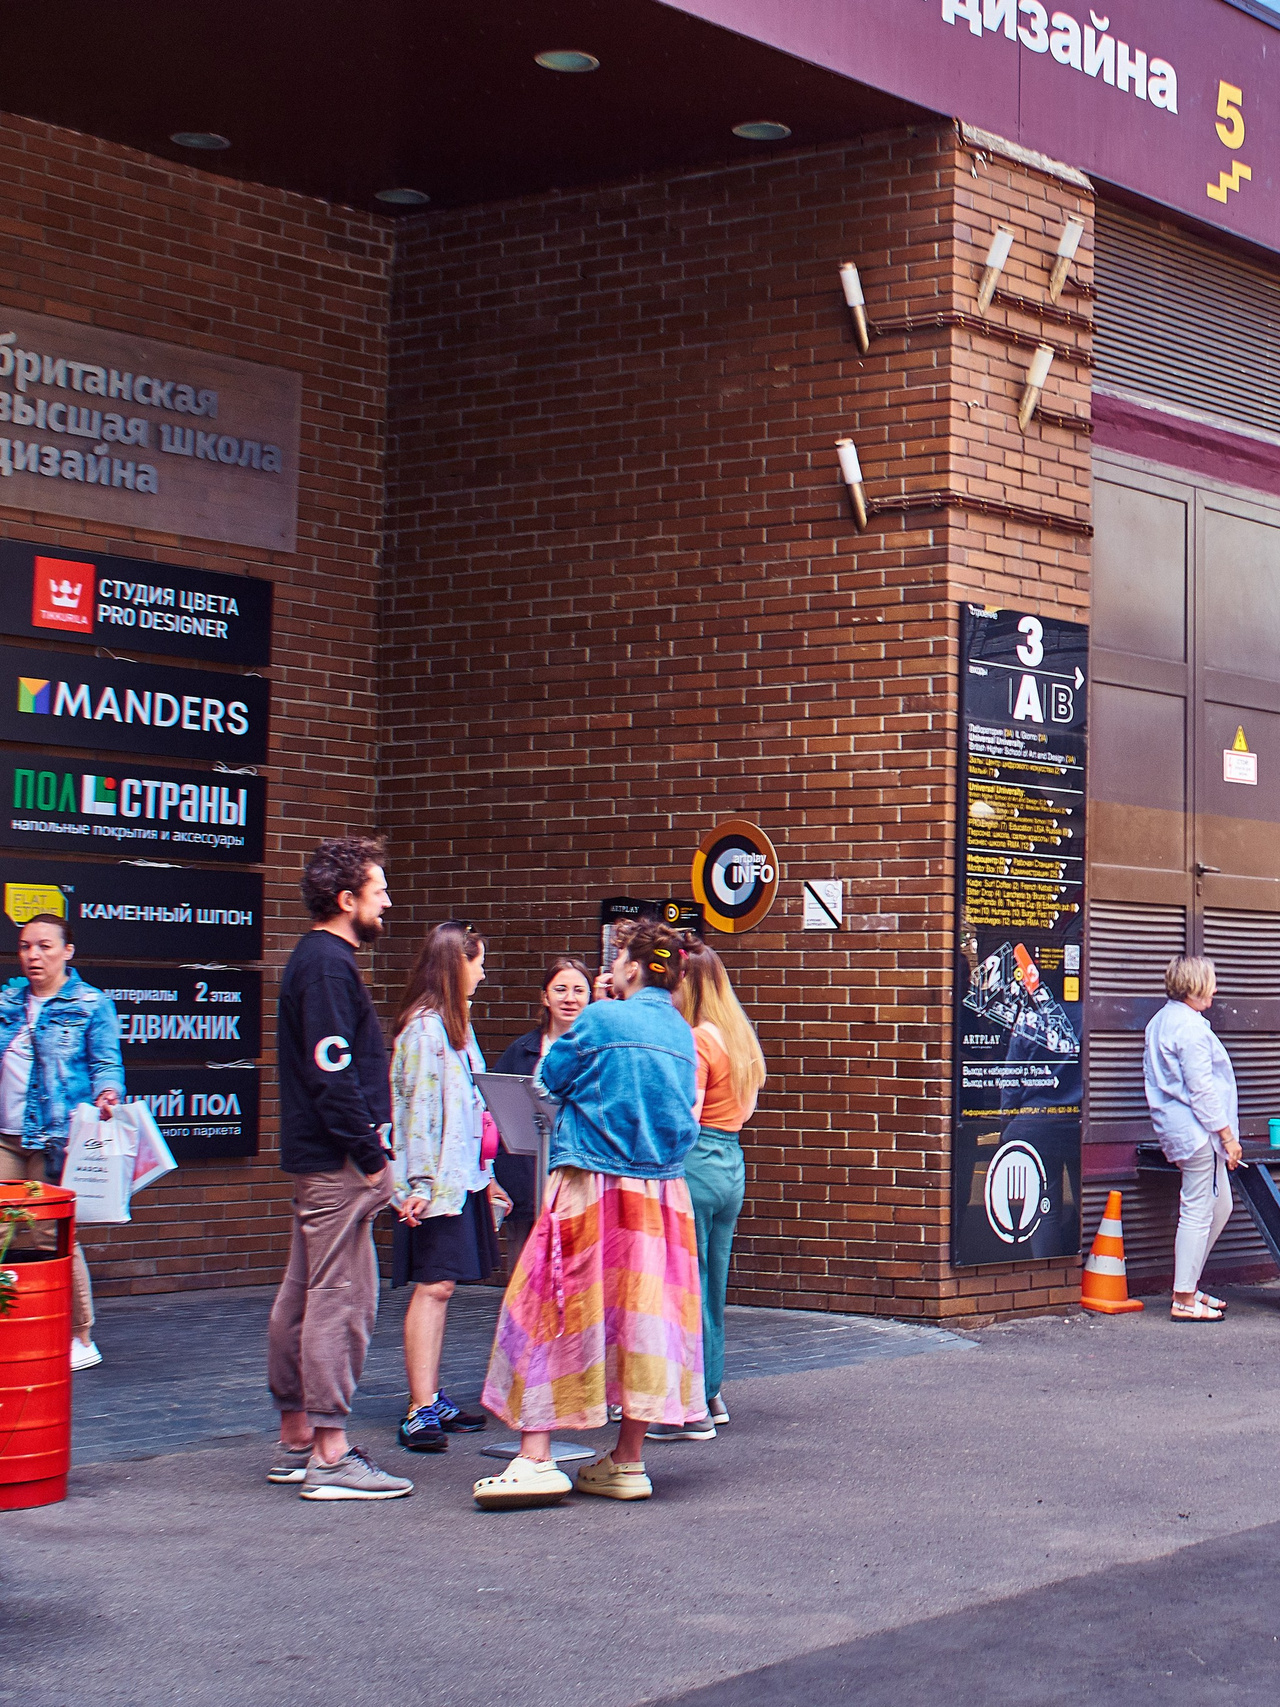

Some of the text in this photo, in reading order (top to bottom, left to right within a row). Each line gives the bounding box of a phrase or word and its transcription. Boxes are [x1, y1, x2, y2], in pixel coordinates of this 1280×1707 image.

[1214, 78, 1245, 150] 5
[0, 331, 219, 419] британская
[158, 423, 282, 474] школа
[99, 579, 240, 617] СТУДИЯ ЦВЕТА
[40, 609, 89, 625] TIKKURILA
[97, 604, 229, 639] PRO DESIGNER
[1015, 615, 1044, 668] 3
[53, 681, 249, 736] MANDERS
[1013, 674, 1045, 723] A
[13, 768, 77, 813] ПОЛ
[11, 819, 245, 848] напольные покрытия и аксессуары
[732, 852, 767, 866] artplay
[732, 864, 775, 884] INFO
[80, 903, 253, 926] КАМЕННЫЙ ШПОН
[195, 981, 208, 1002] 2
[209, 990, 242, 1003] этаж
[117, 1014, 241, 1044] ЕДВИЖНИК
[962, 1034, 1000, 1045] ARTPLAY
[313, 1035, 352, 1072] C
[191, 1093, 242, 1117] ПОЛ
[193, 1126, 242, 1138] паркета
